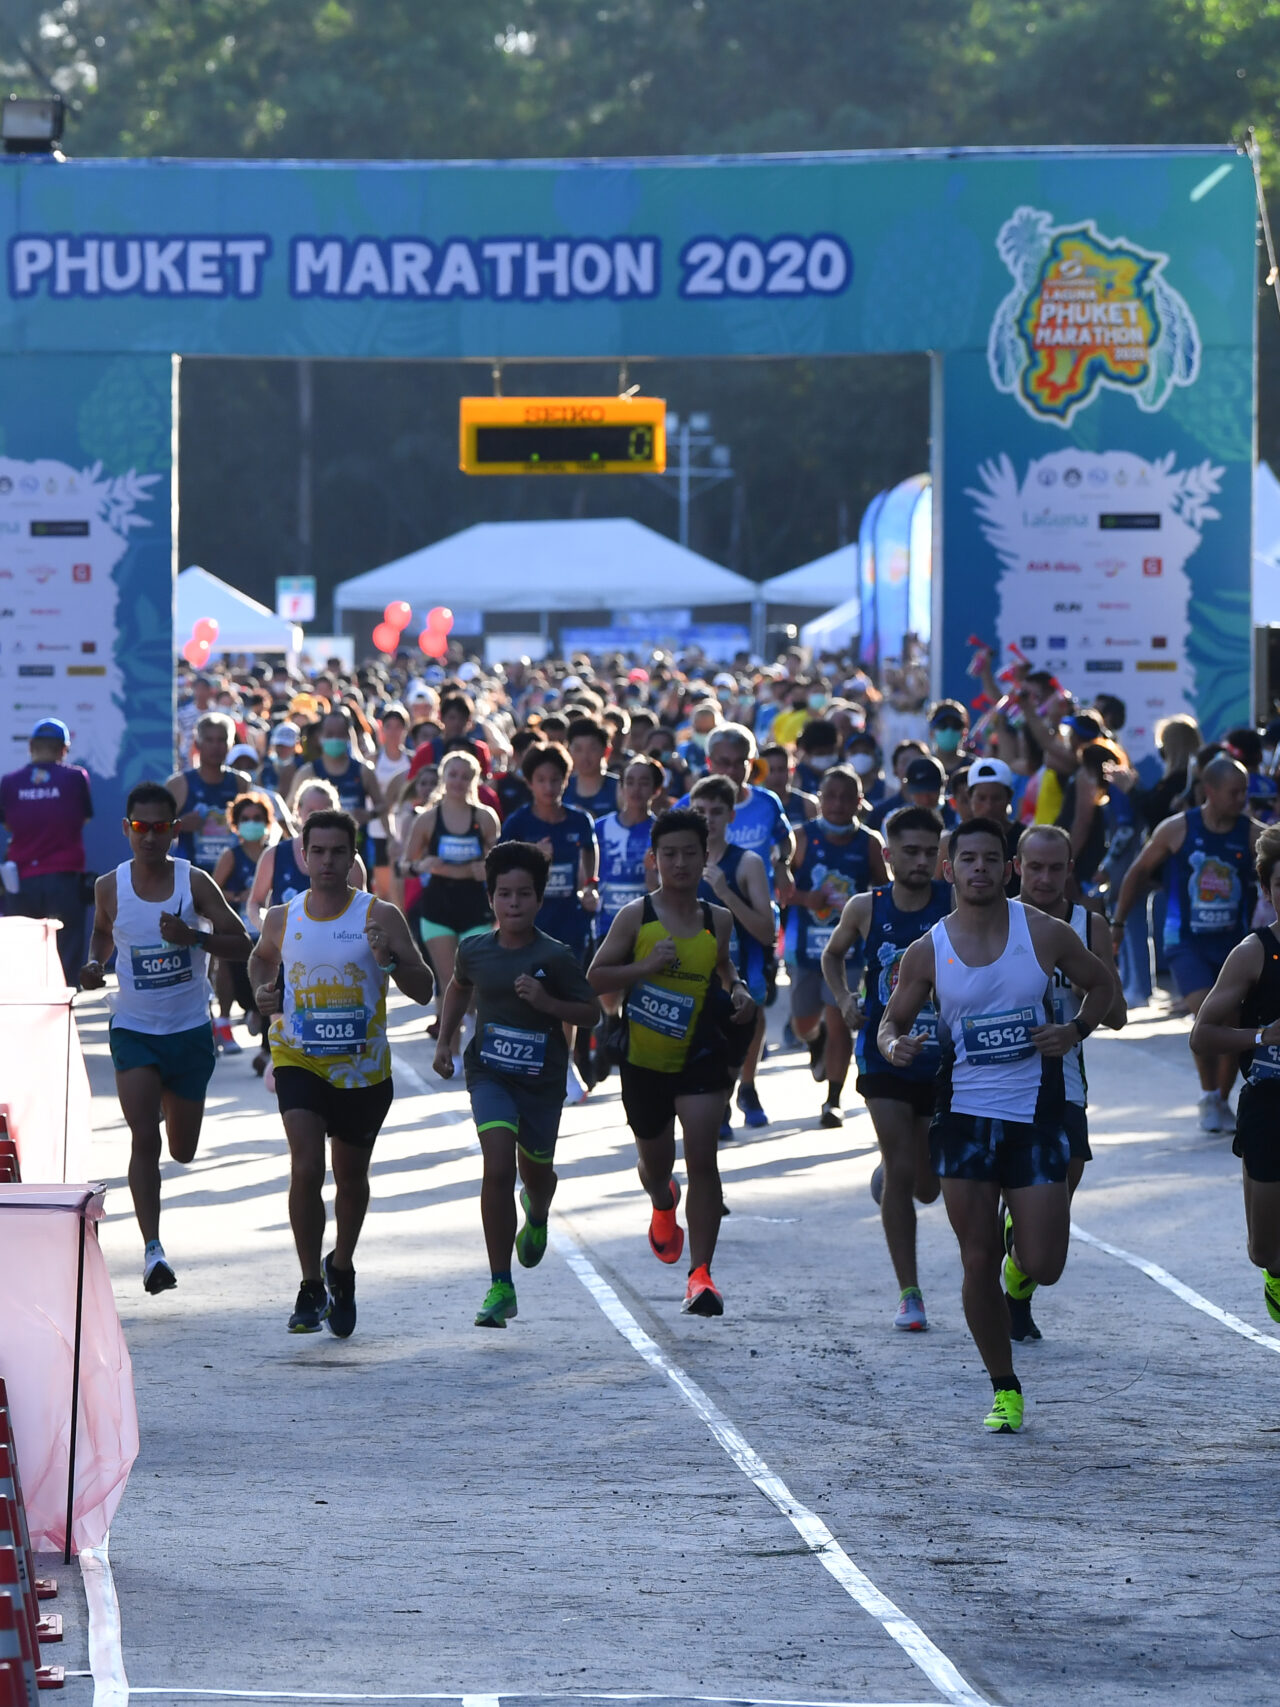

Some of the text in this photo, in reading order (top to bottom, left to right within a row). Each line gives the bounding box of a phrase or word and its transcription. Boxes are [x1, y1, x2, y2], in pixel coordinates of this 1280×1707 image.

[12, 238, 266, 294] PHUKET
[295, 240, 655, 296] MARATHON
[684, 239, 847, 294] 2020
[1040, 302, 1140, 325] PHUKET
[1035, 325, 1144, 345] MARATHON
[524, 405, 606, 423] SEIKO
[141, 955, 182, 974] 9040
[640, 995, 681, 1021] 9088
[315, 1023, 355, 1038] 9018
[977, 1026, 1028, 1047] 9592
[493, 1038, 535, 1060] 9072
